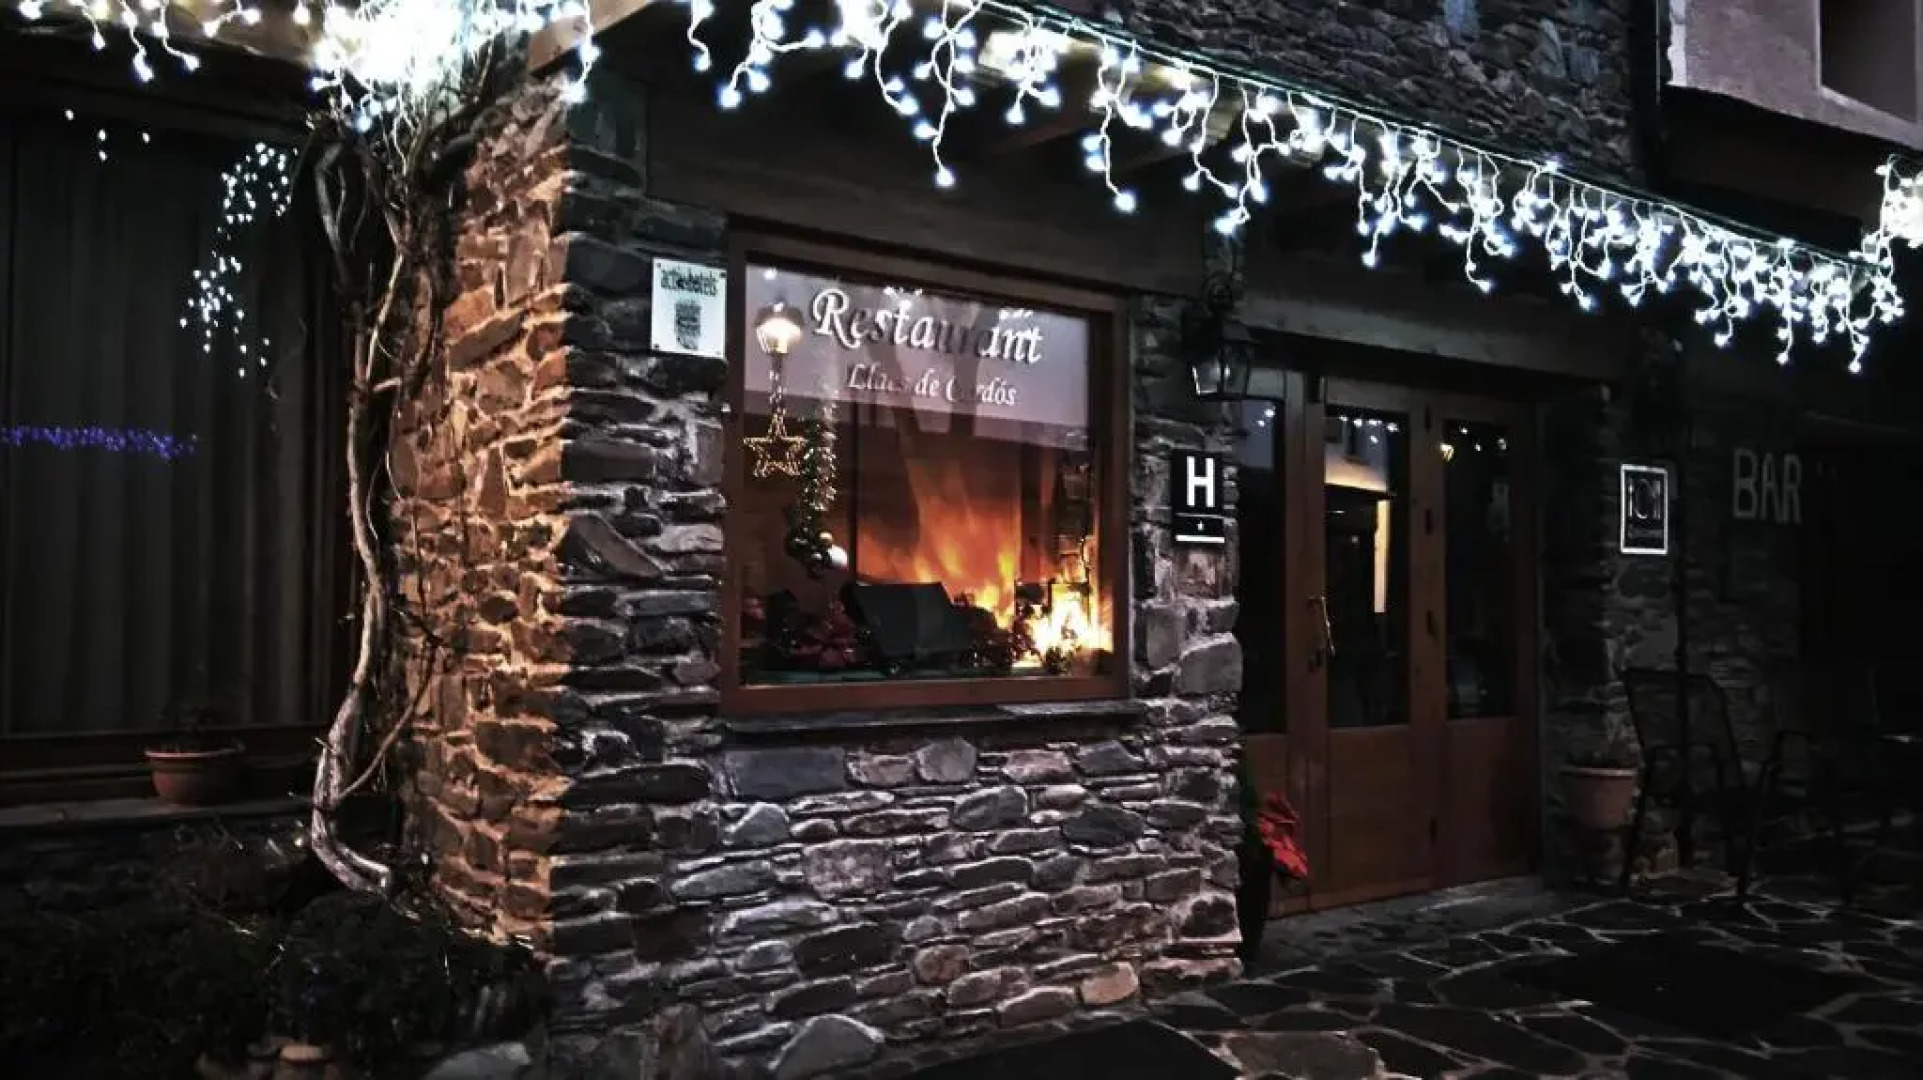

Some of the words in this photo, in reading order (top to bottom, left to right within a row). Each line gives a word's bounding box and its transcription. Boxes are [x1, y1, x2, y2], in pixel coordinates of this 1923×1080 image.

[812, 288, 1043, 364] Restaurant
[914, 367, 940, 397] de
[945, 374, 1016, 406] Crdós
[1187, 456, 1215, 508] H
[1733, 448, 1802, 524] BAR
